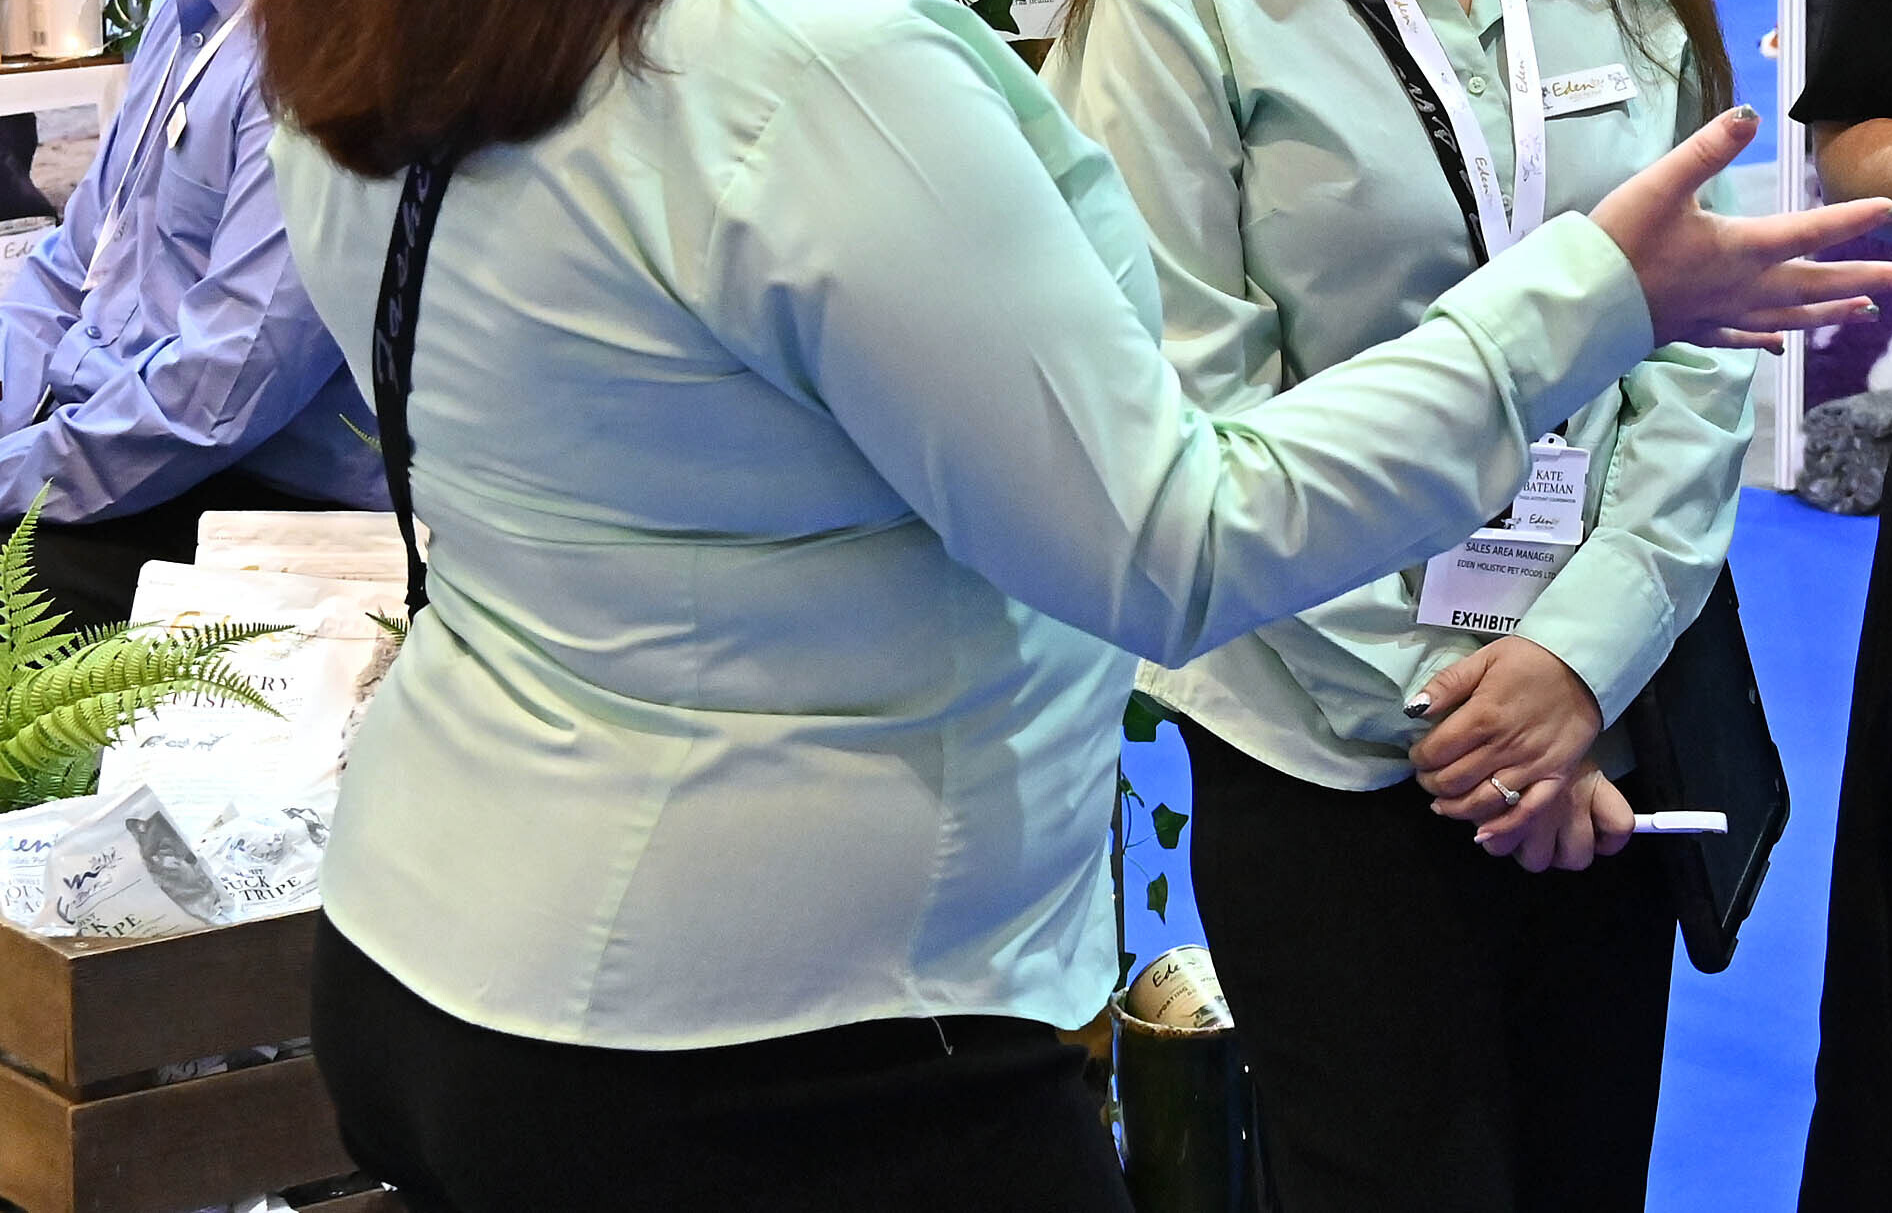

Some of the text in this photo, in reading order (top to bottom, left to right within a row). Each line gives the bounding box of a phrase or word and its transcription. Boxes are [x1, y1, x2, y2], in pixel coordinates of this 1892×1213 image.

[1552, 81, 1595, 98] Eden
[1474, 156, 1491, 196] Eden
[1536, 469, 1564, 483] KATE
[1523, 481, 1575, 496] BATEMAN
[1528, 513, 1554, 525] Eden
[1466, 541, 1556, 563] SALES AREA MANAGER
[1457, 559, 1556, 580] EDEN HOLISTIC PET FOODS LTD
[1451, 610, 1521, 632] EXHIBIT
[226, 875, 271, 890] UCK
[238, 875, 302, 902] TRIPE
[1152, 963, 1183, 987] Ede
